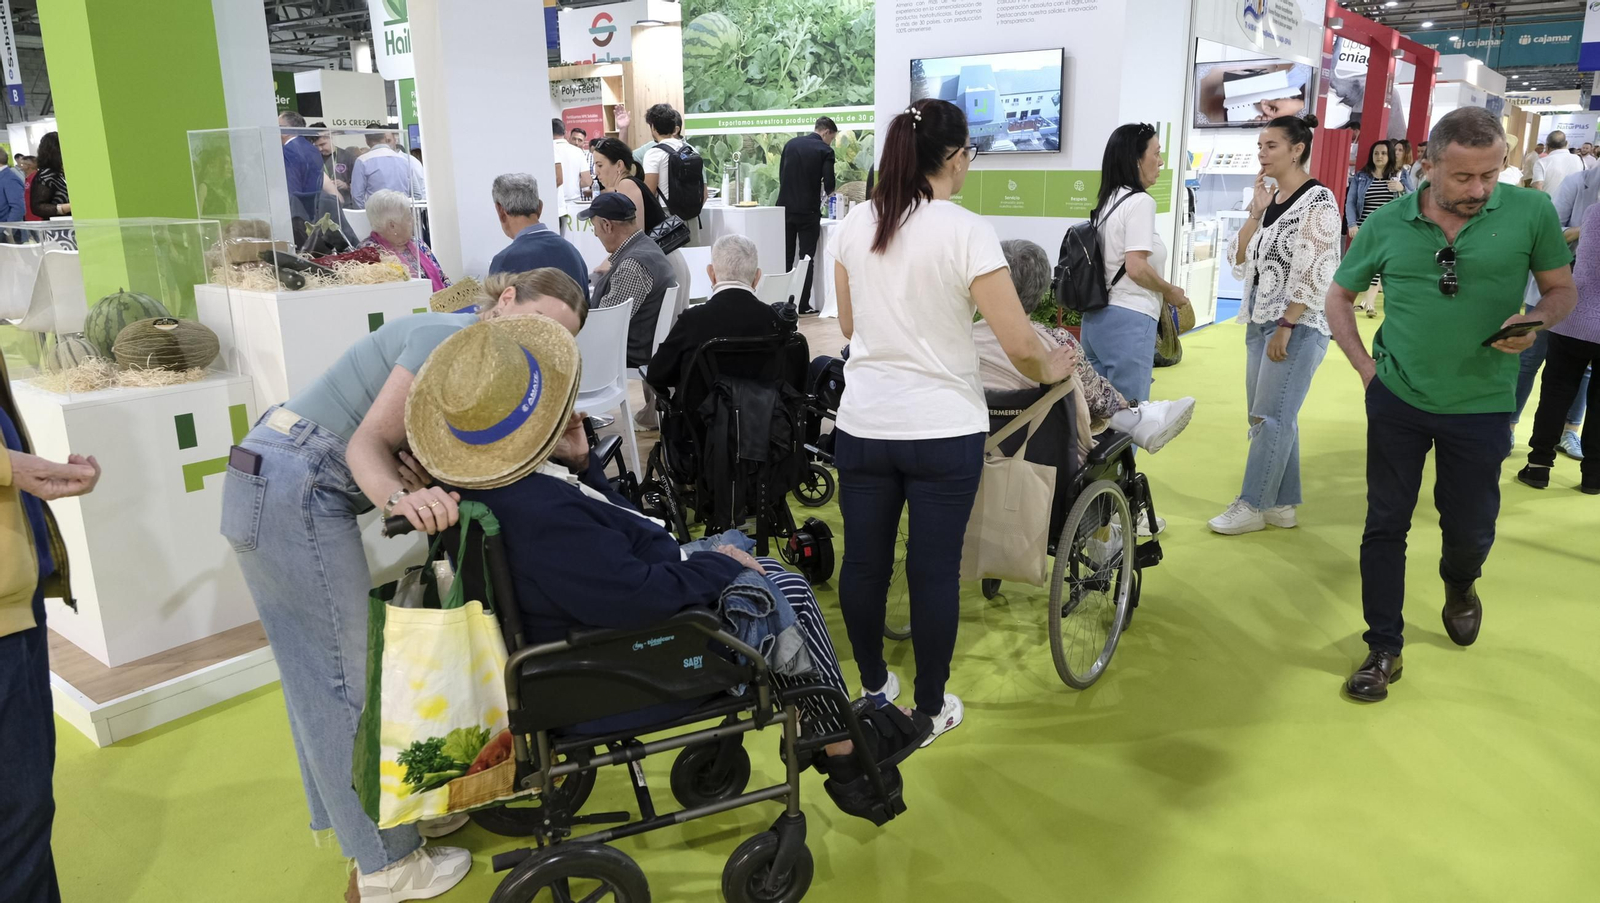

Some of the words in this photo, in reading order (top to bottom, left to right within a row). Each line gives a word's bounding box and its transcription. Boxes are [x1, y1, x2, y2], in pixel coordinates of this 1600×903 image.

[935, 2, 974, 10] comercialización
[0, 0, 14, 68] Sabade
[1534, 34, 1572, 44] cajamar
[1467, 39, 1504, 48] cajamar
[13, 90, 18, 102] B
[683, 655, 703, 668] SABY
